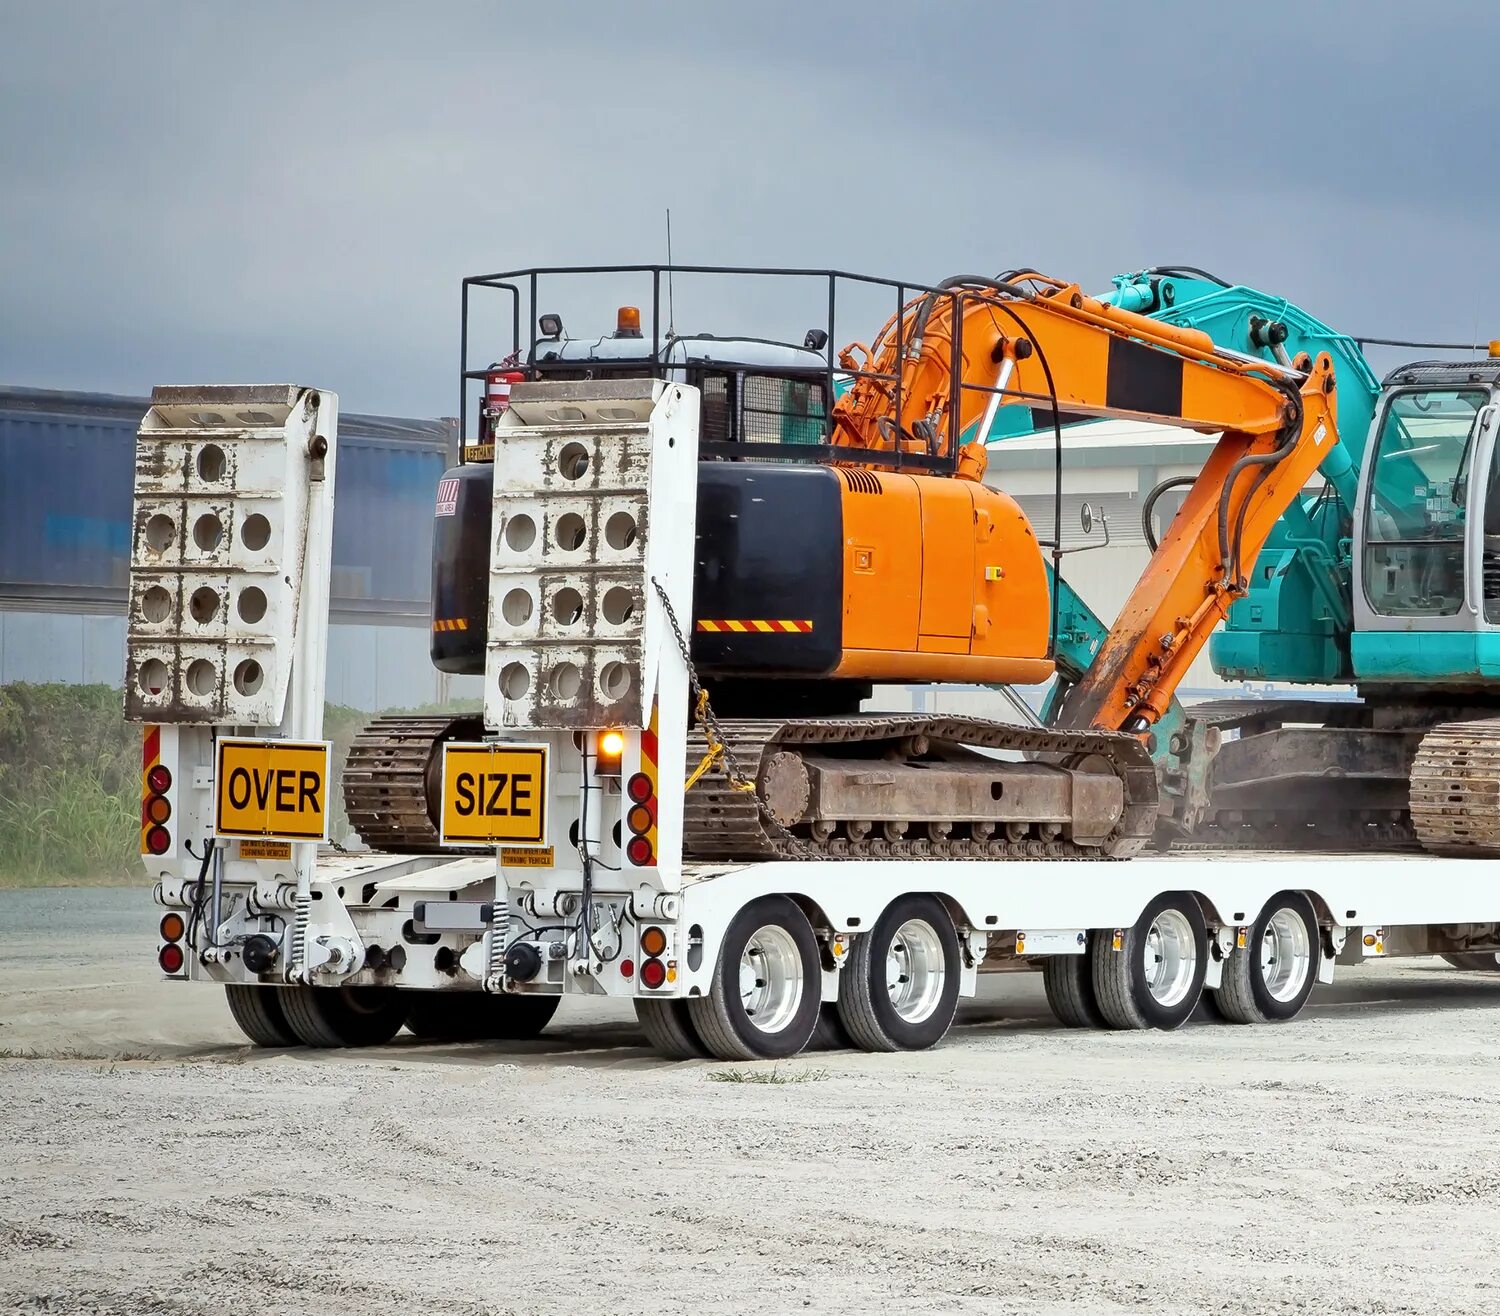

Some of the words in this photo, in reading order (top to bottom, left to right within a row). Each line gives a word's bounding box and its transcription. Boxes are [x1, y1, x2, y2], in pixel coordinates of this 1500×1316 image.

[229, 767, 321, 813] OVER
[455, 772, 532, 816] SIZE
[241, 849, 266, 857] TURNING
[267, 849, 289, 857] VEHICLE
[503, 856, 527, 864] TURNING
[528, 856, 551, 865] VEHICLE
